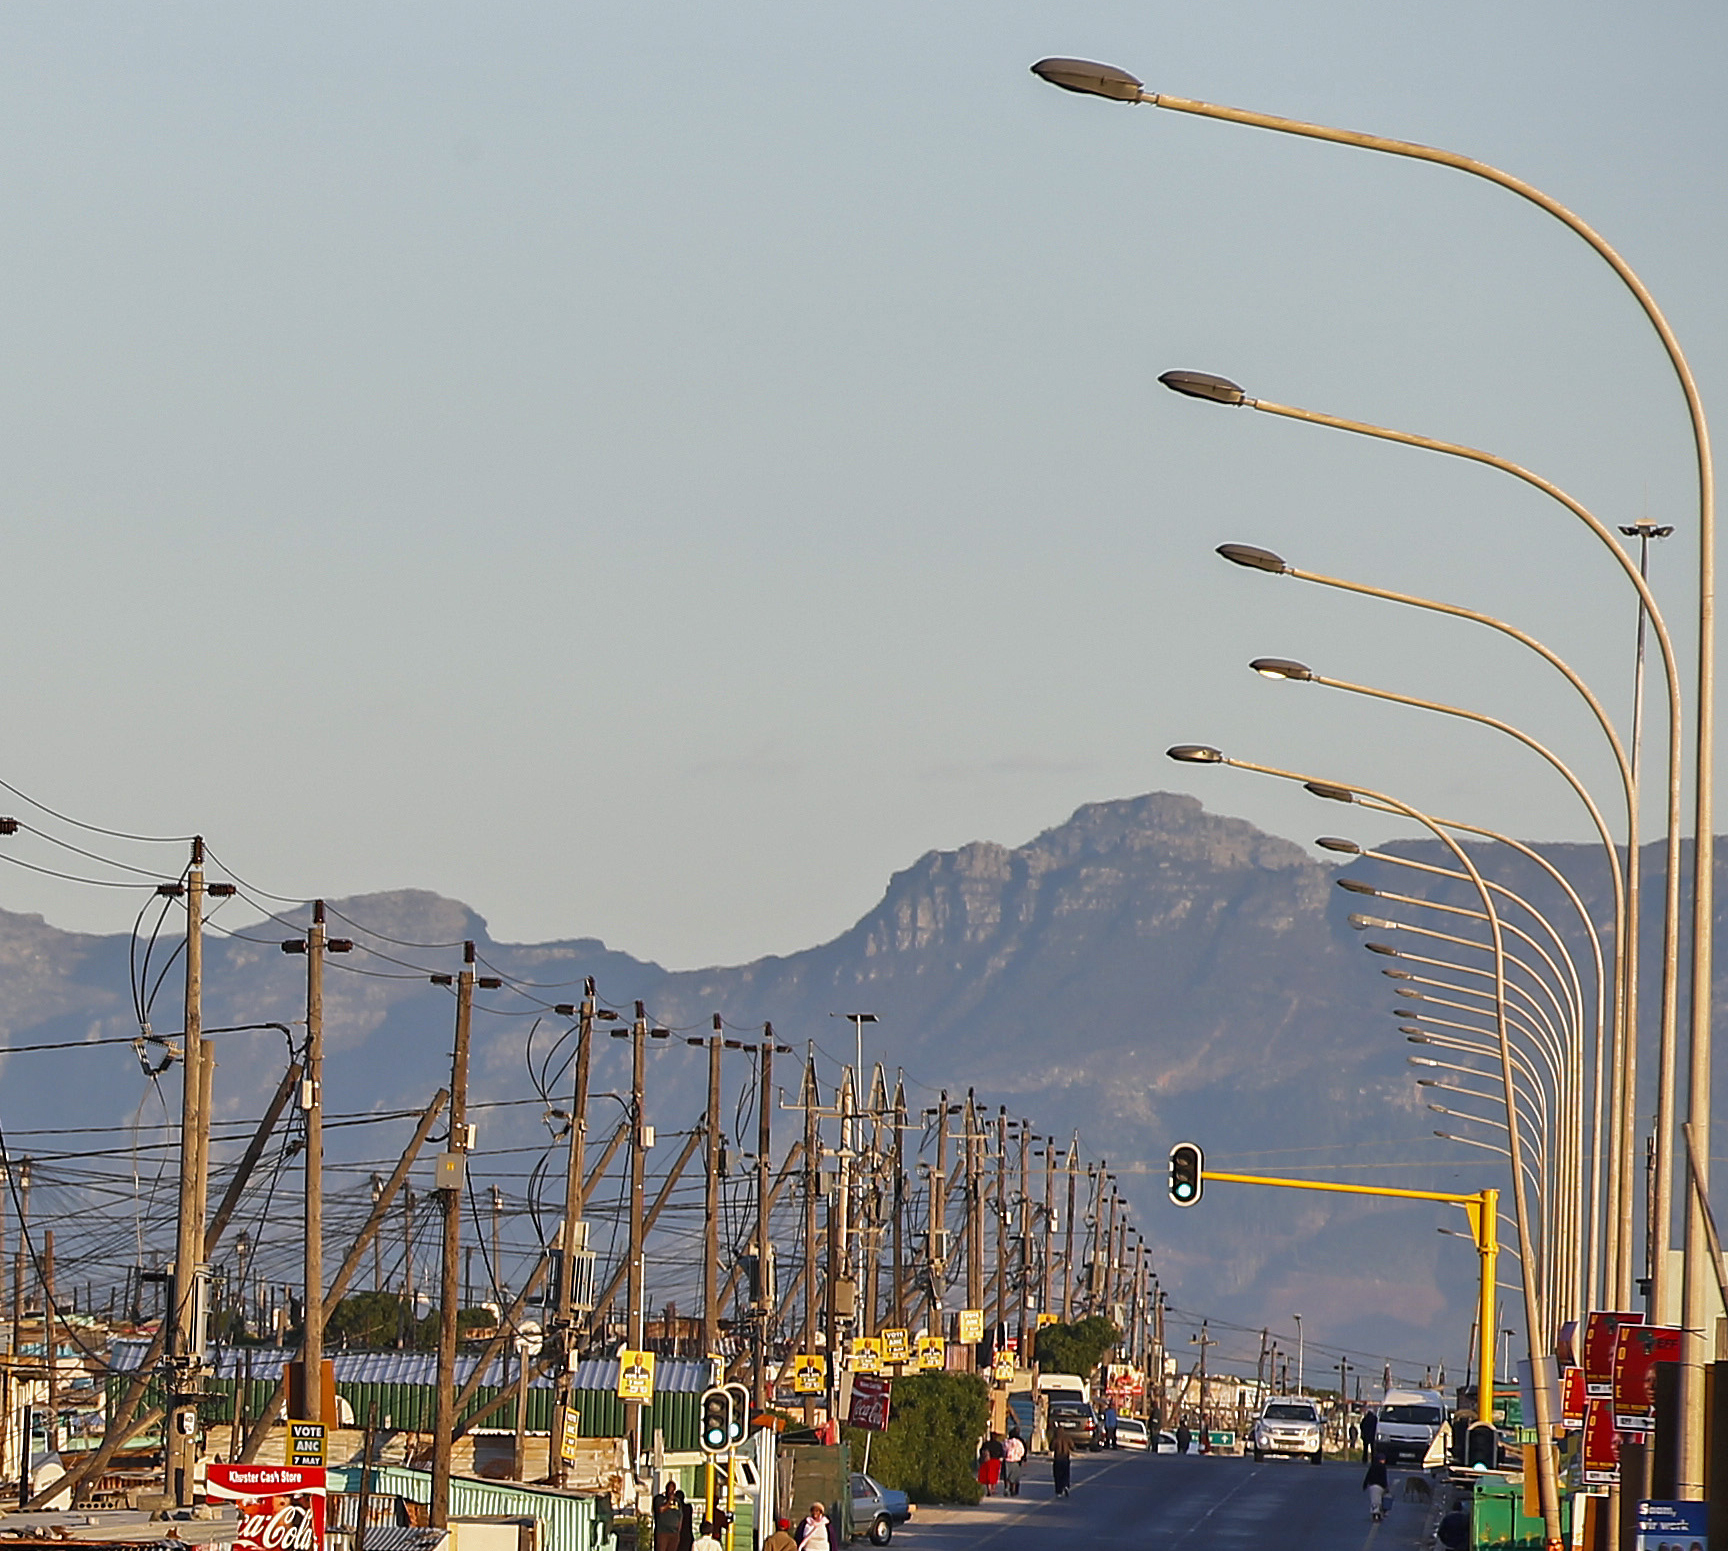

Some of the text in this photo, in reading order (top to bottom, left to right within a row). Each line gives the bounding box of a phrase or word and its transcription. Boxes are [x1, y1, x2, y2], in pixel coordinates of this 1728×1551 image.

[294, 1426, 322, 1437] VOTE
[296, 1441, 320, 1452] ANC
[281, 1471, 302, 1483] Store
